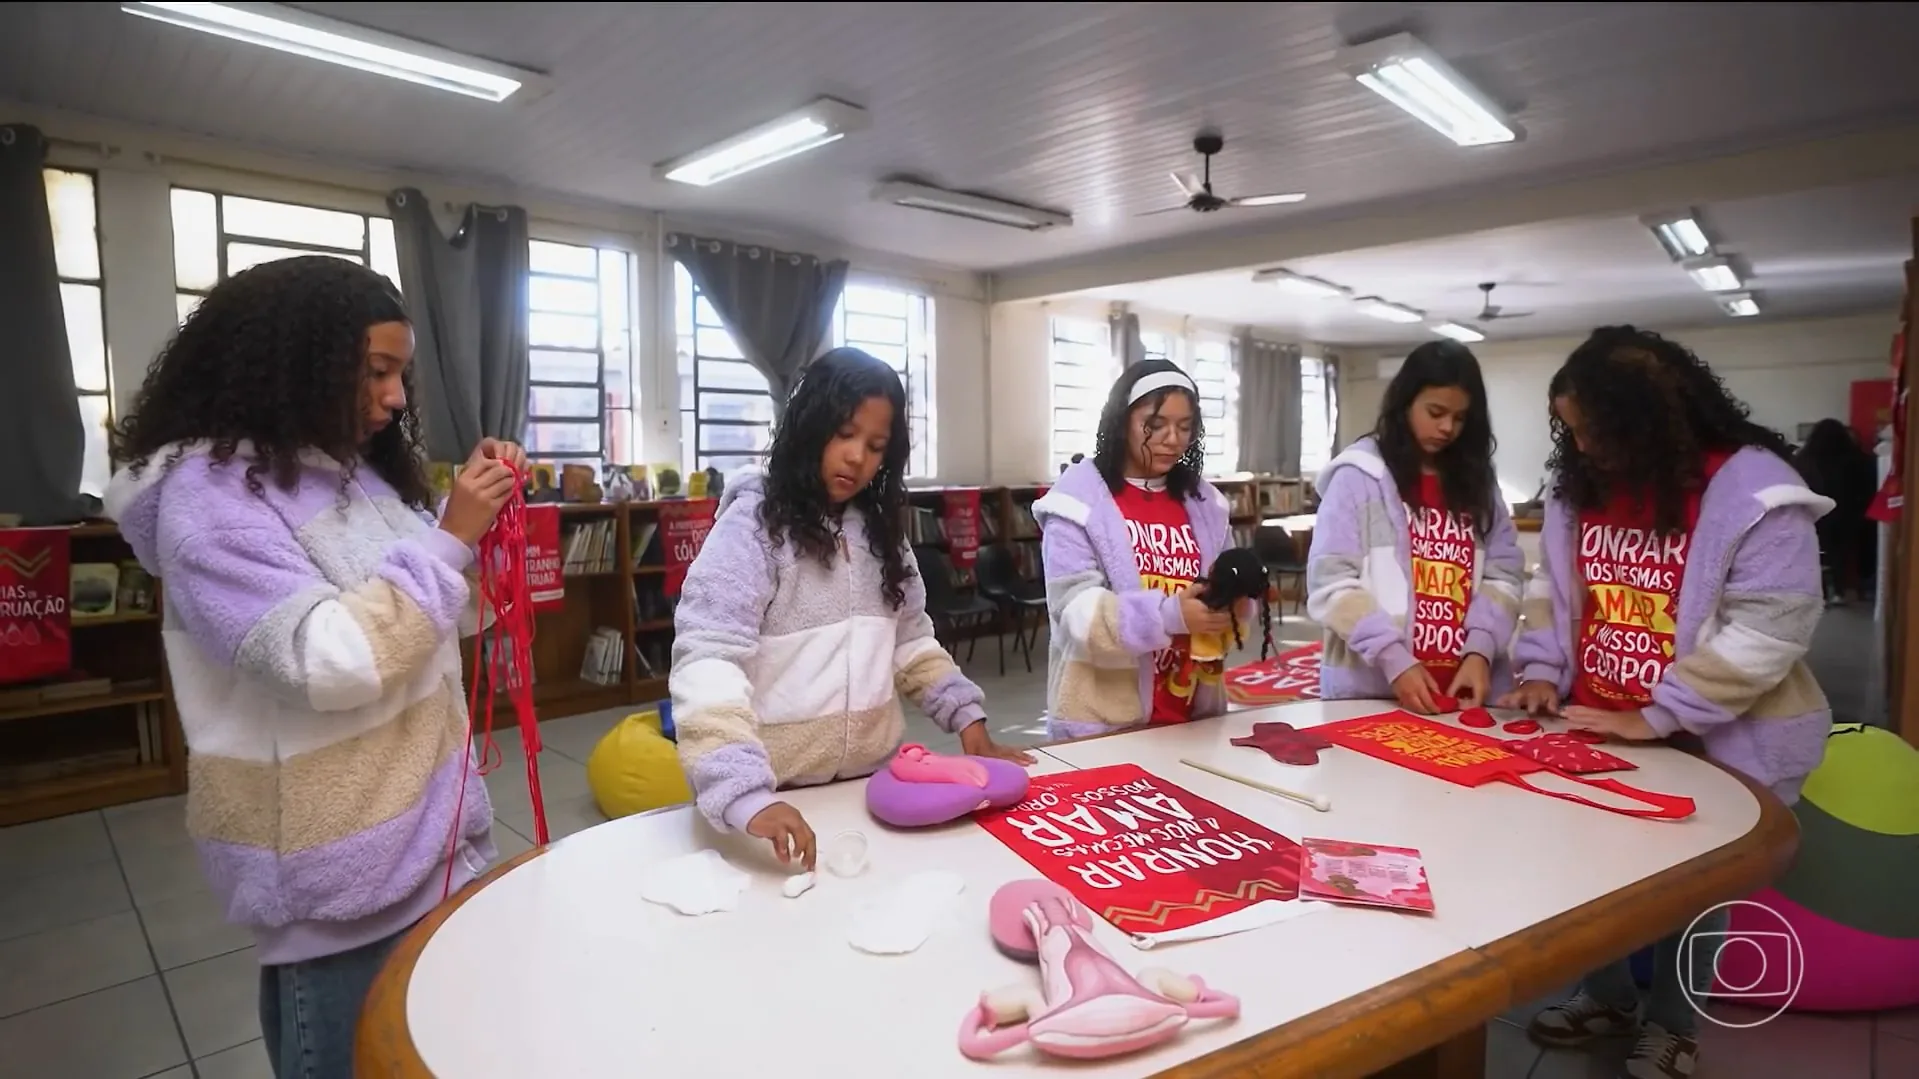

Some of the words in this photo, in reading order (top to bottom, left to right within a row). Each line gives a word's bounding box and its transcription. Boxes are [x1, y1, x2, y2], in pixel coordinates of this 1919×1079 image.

[1125, 519, 1200, 556] ONRAR
[1403, 502, 1475, 541] NRAR
[1581, 522, 1687, 565] ONRAR
[0, 585, 26, 599] IAS
[0, 594, 65, 620] RUAÇÃO
[1416, 600, 1454, 621] SSOS
[1413, 623, 1465, 657] RPOS
[1071, 777, 1157, 804] NOSSOS
[1005, 792, 1196, 848] AMAR
